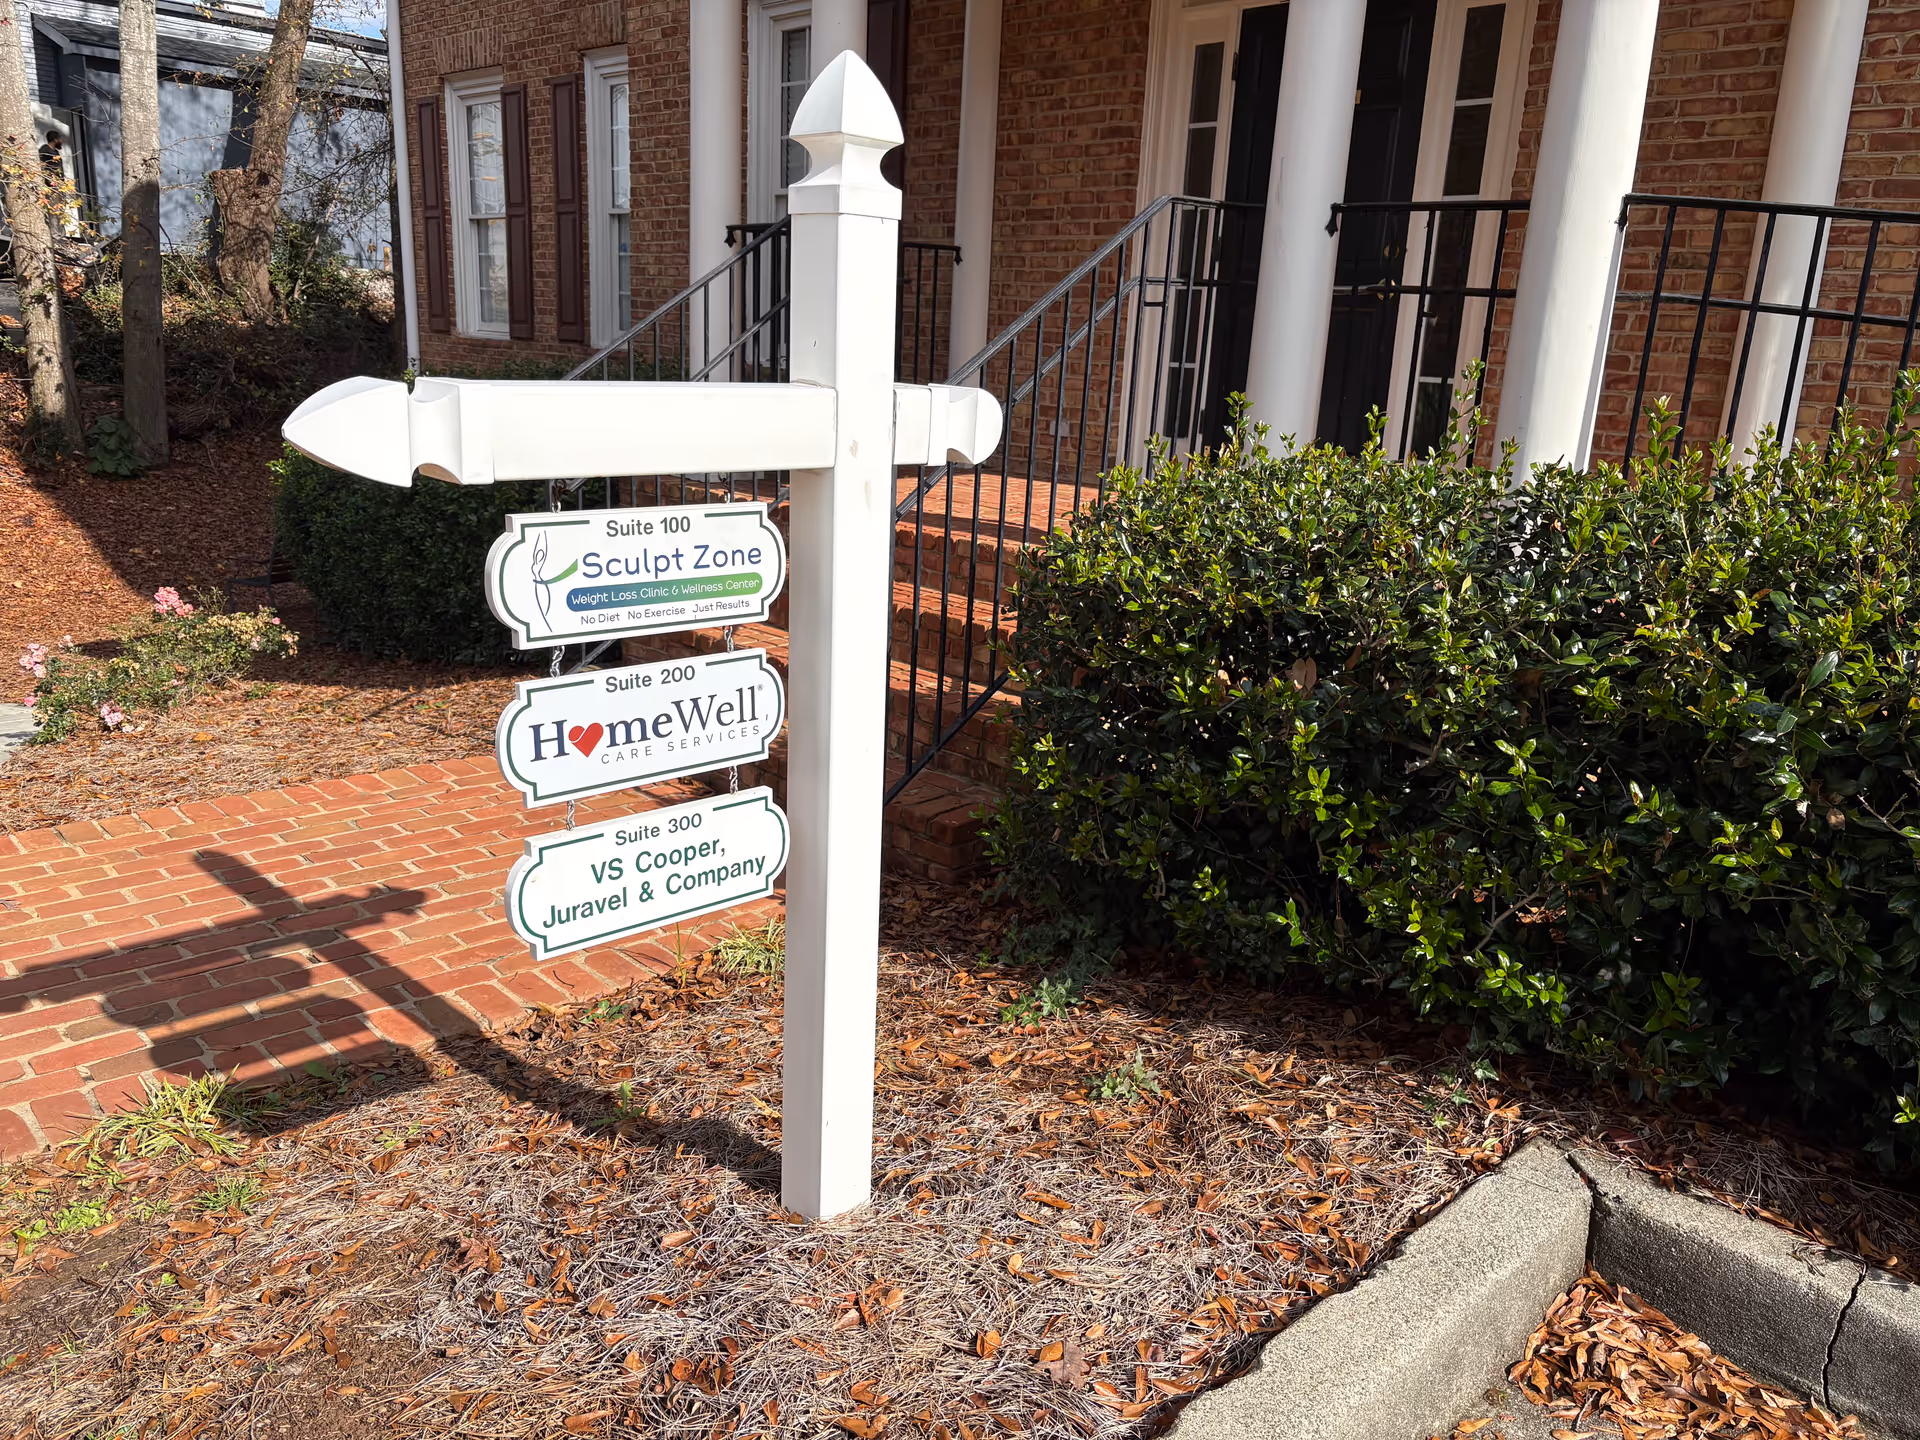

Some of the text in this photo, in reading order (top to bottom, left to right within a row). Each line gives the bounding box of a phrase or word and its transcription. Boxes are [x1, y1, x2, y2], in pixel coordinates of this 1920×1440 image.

[606, 516, 691, 537] Suite 100
[582, 544, 762, 579] Sculpt Zone
[571, 579, 760, 605] Weight Loss Clinic & Wellness Center
[581, 599, 750, 625] No Diet No Exercise Just Results
[605, 665, 696, 693] Suite 200
[601, 724, 760, 765] CARE SERVICES
[614, 813, 702, 846] Suite 300
[590, 838, 726, 884] VS Cooper,
[542, 855, 766, 929] Juravel & Company
